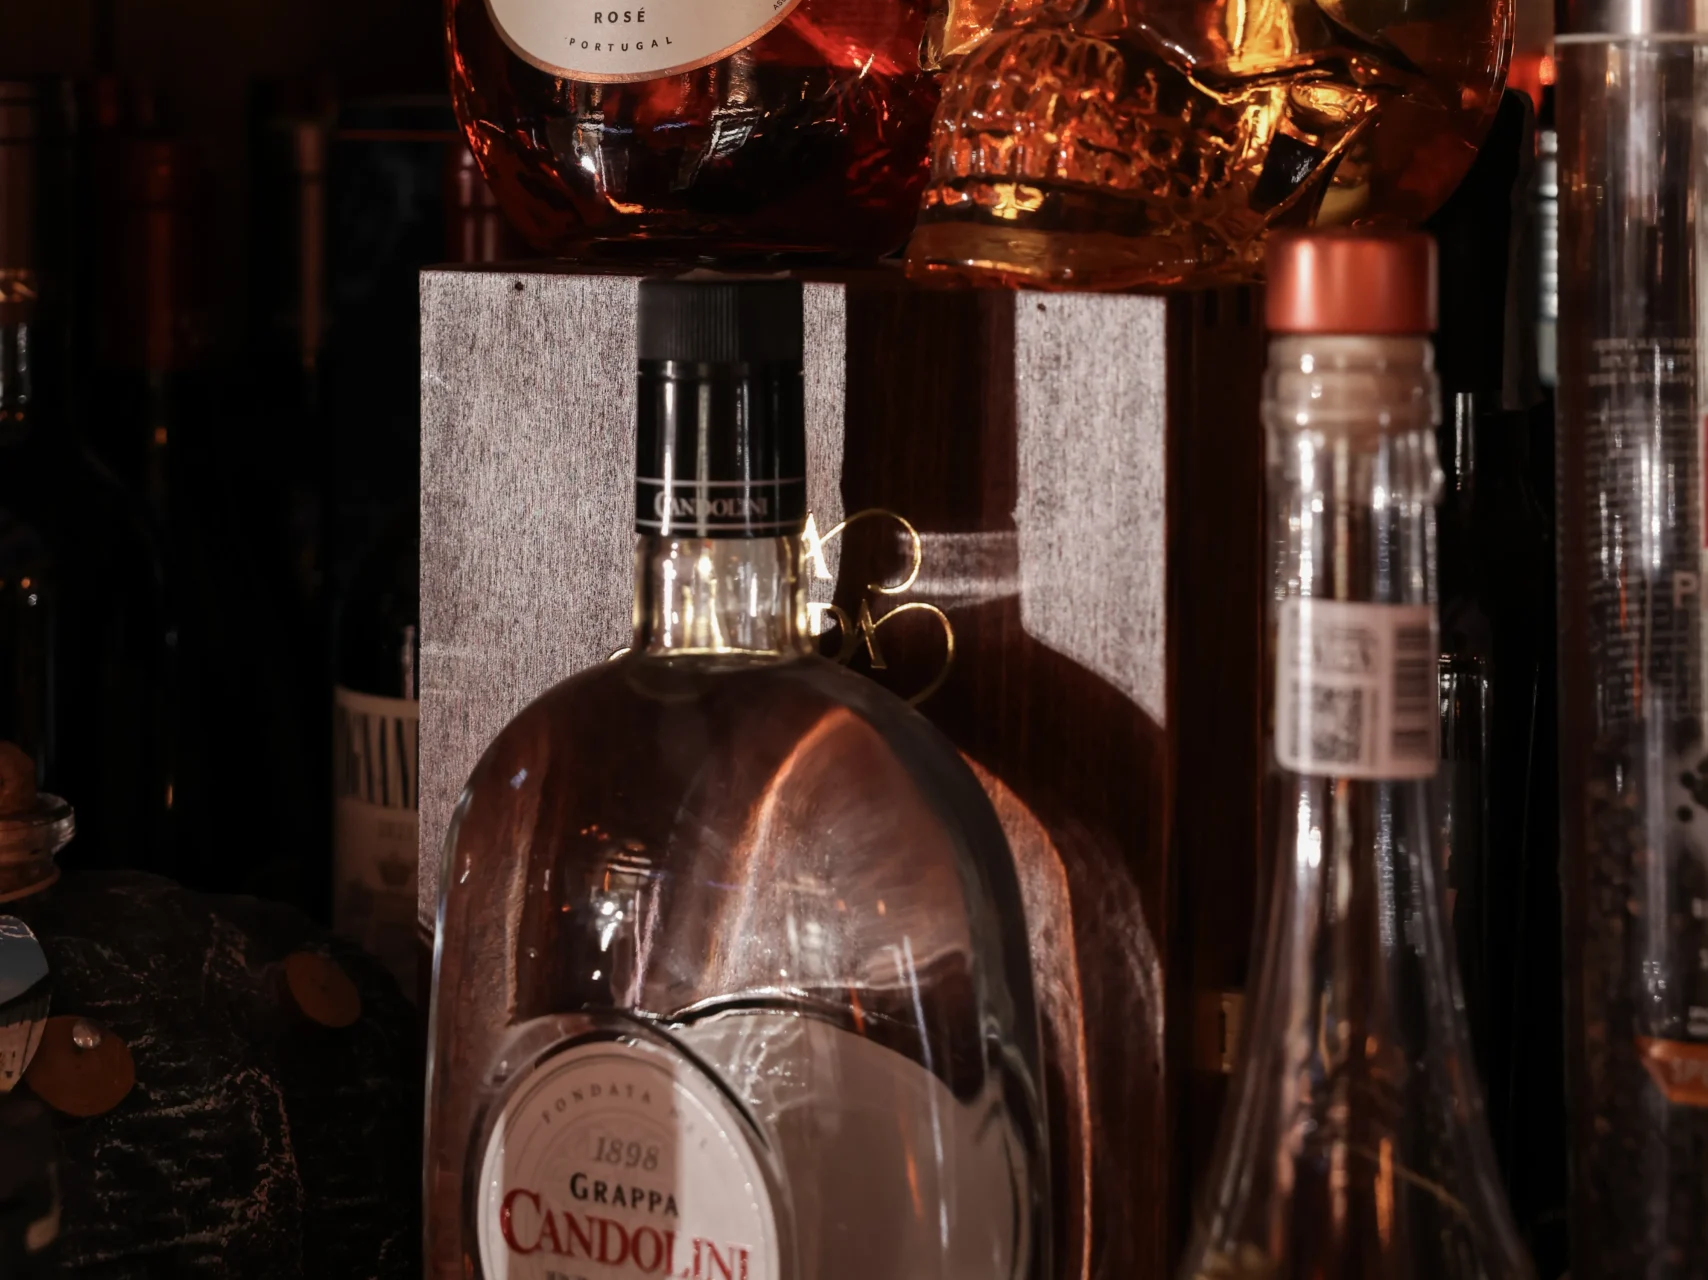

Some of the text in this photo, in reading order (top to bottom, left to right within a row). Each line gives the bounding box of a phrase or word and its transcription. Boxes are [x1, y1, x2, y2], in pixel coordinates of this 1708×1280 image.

[594, 7, 646, 24] ROSÉ
[569, 36, 672, 52] PORTUGAL
[592, 1136, 659, 1171] 1898
[570, 1173, 680, 1217] GRAPPA
[500, 1188, 752, 1280] CANDOLINI
